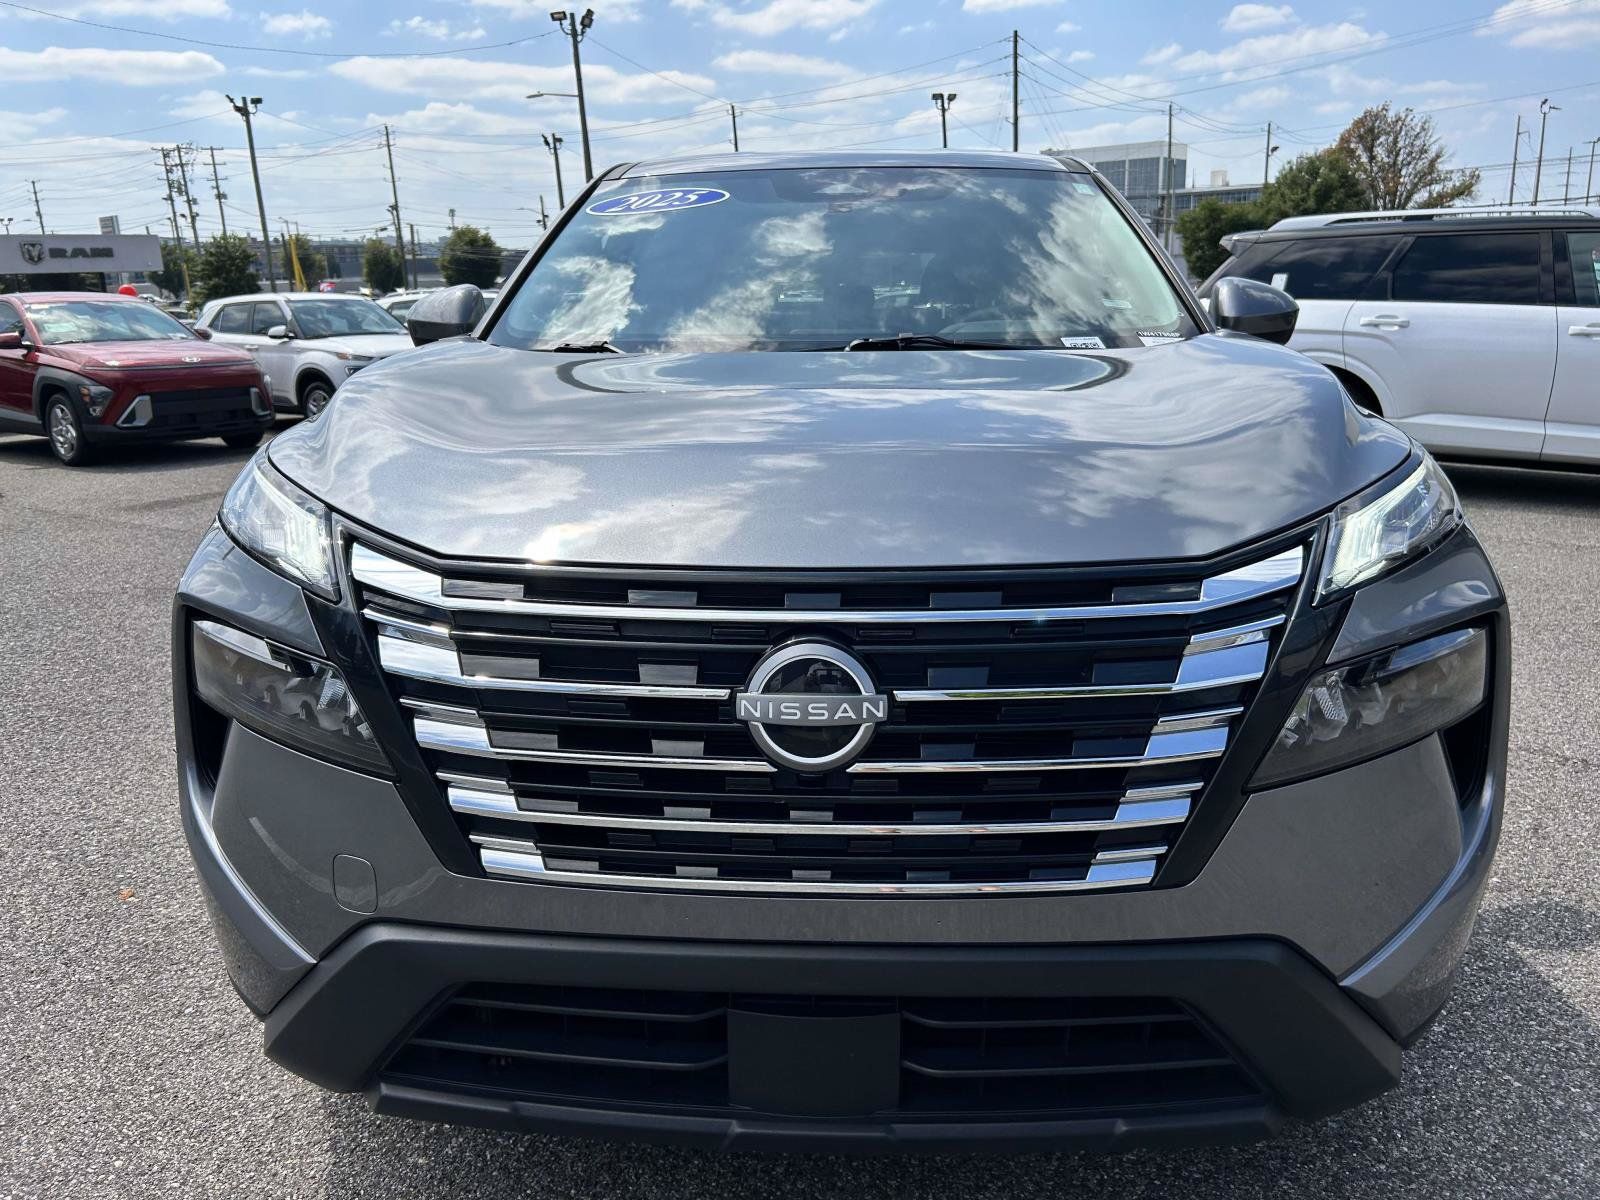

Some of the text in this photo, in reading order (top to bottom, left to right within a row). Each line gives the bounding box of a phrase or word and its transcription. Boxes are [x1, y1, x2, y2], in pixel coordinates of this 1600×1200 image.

[606, 190, 710, 212] 2025
[48, 247, 114, 258] RAM
[739, 699, 884, 720] NISSAN
